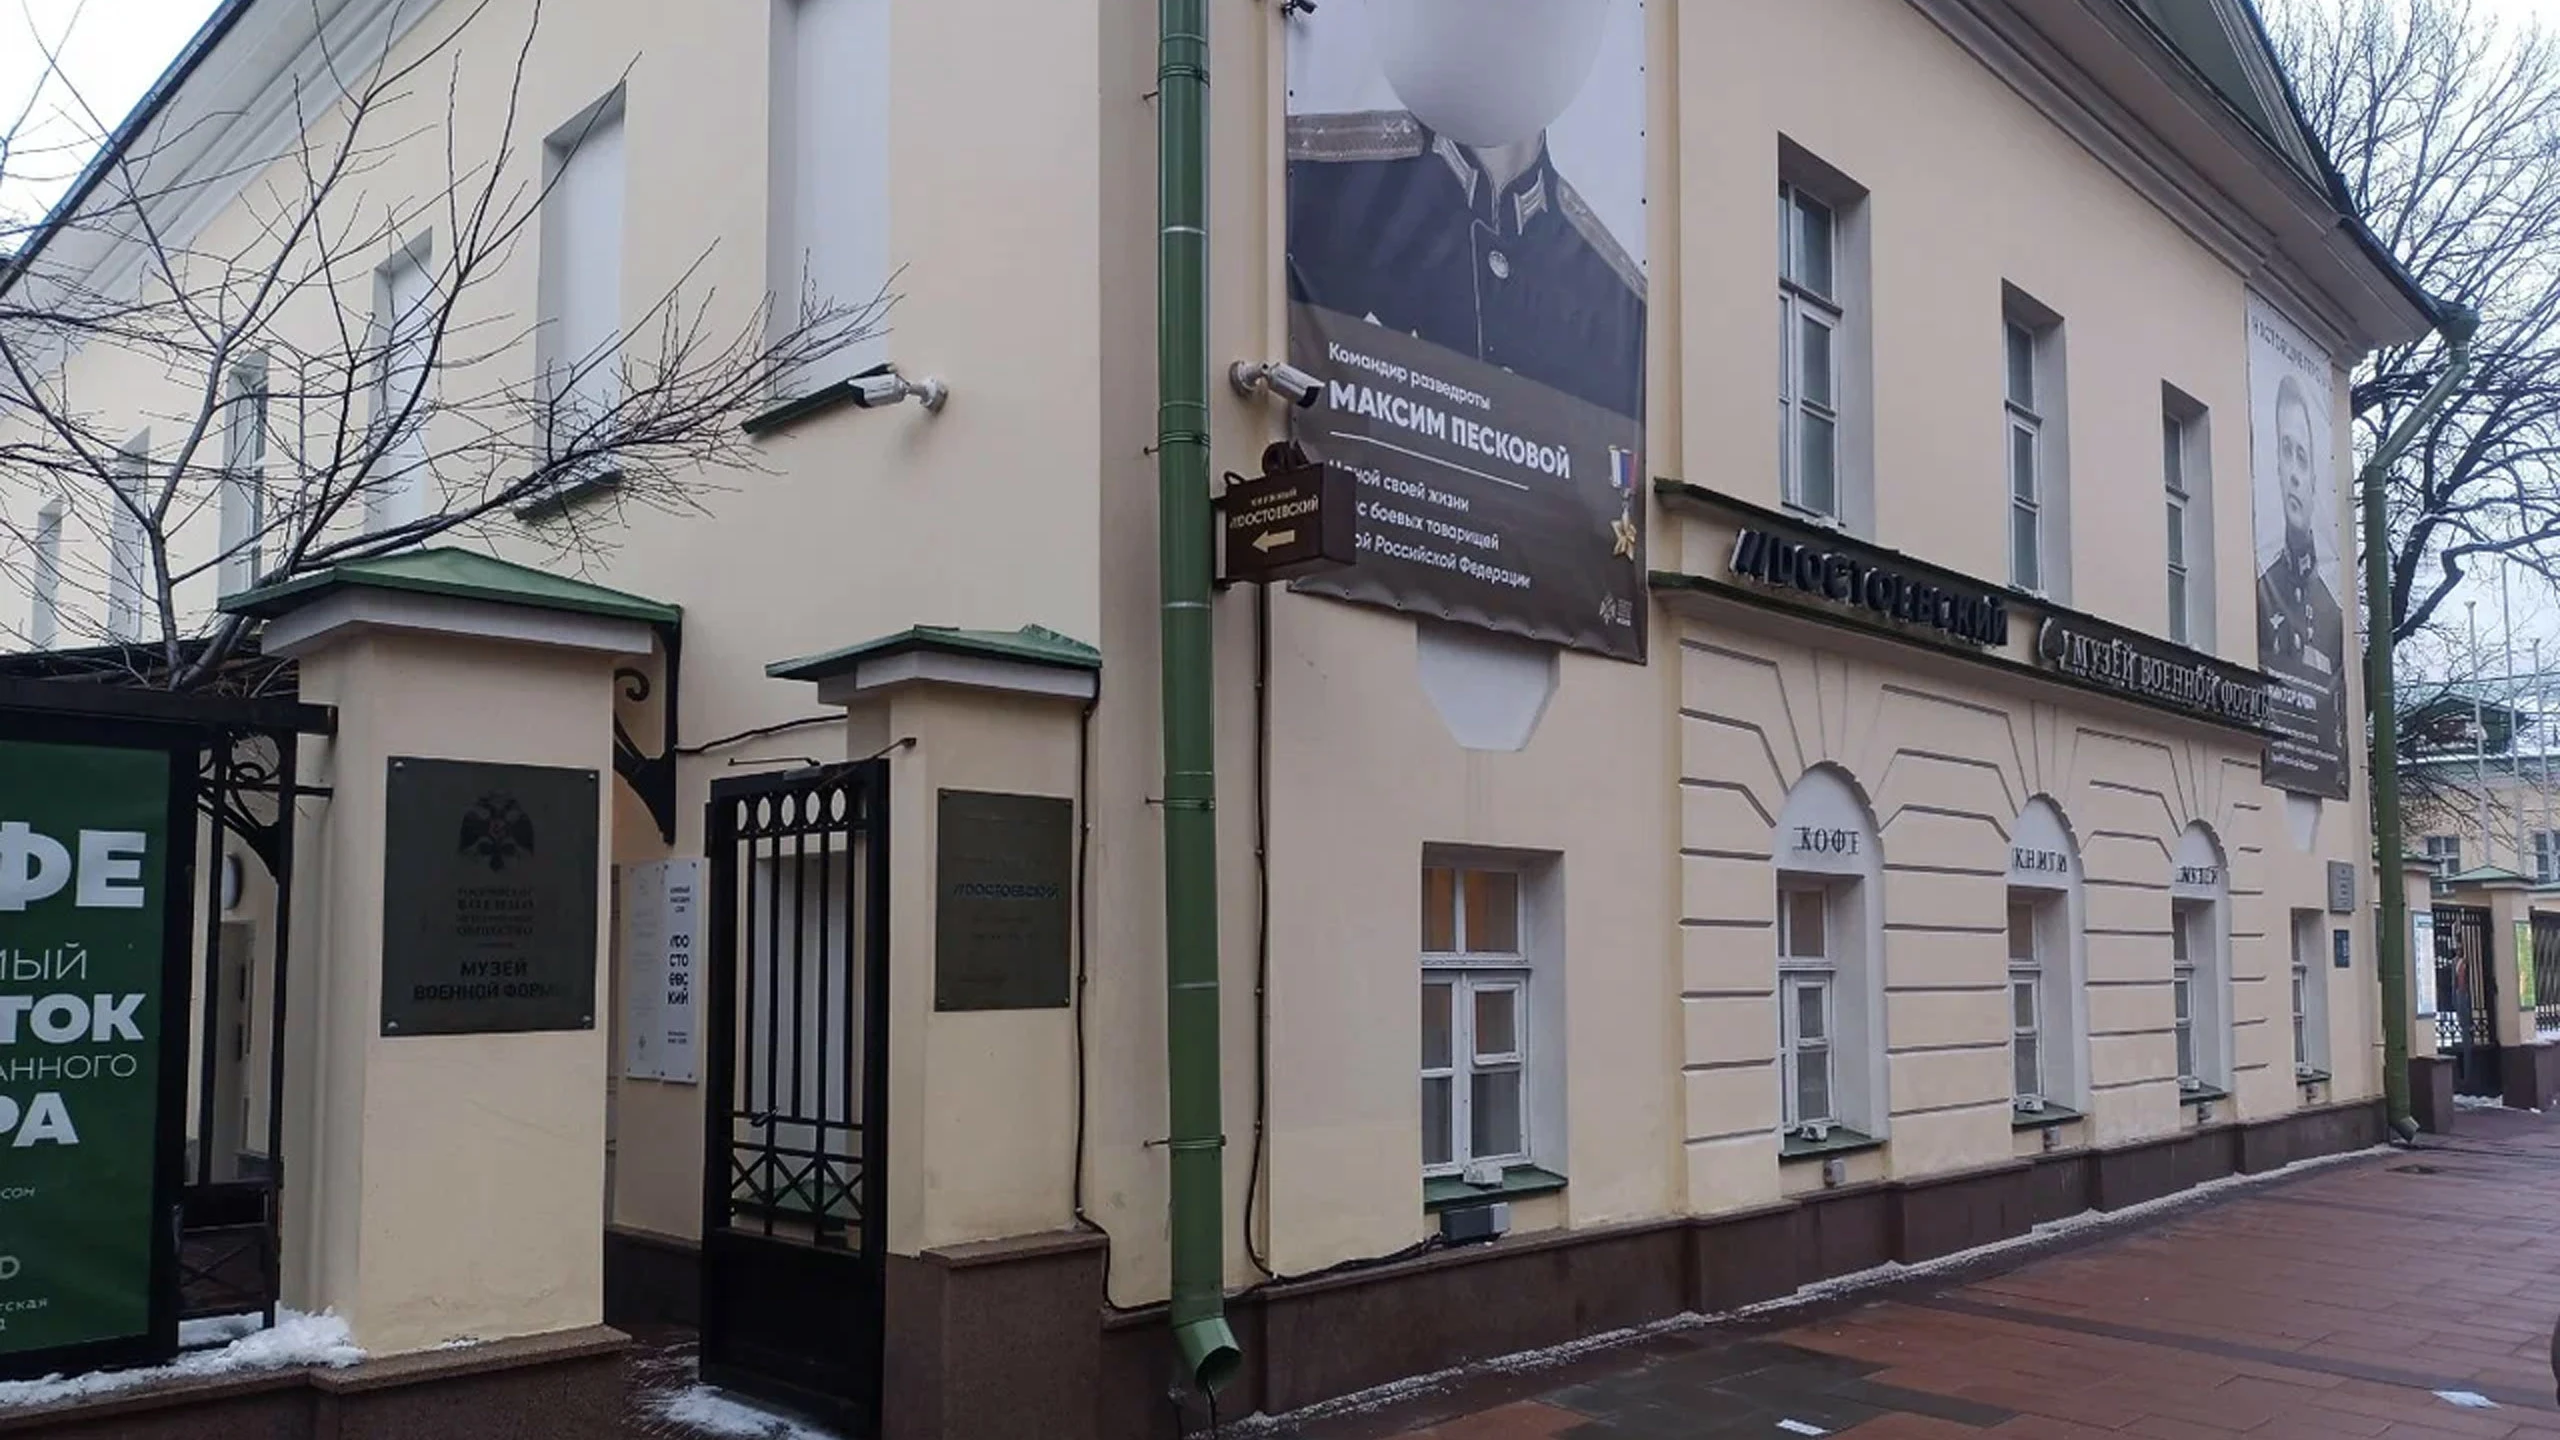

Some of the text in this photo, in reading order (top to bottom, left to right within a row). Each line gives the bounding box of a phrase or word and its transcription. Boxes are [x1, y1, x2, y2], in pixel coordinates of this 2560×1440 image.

[1328, 341, 1491, 410] Командир разведроты
[1329, 379, 1570, 479] МАКСИМ ПЕСКОВОЙ
[1383, 476, 1426, 499] своей
[1427, 487, 1469, 513] жизни
[1370, 501, 1423, 531] боевых
[1425, 518, 1499, 551] товарищей
[1374, 534, 1457, 571] Российской
[1458, 555, 1531, 589] Федерации
[2073, 633, 2137, 687] МУЗЕЙ
[2140, 655, 2219, 710] ВОЕННОЙ
[1792, 827, 1859, 855] КОФЕ
[460, 957, 528, 977] МУЗЕЙ
[669, 953, 689, 967] СТО
[413, 981, 566, 1001] ВОЕННОЙ ФОРМ
